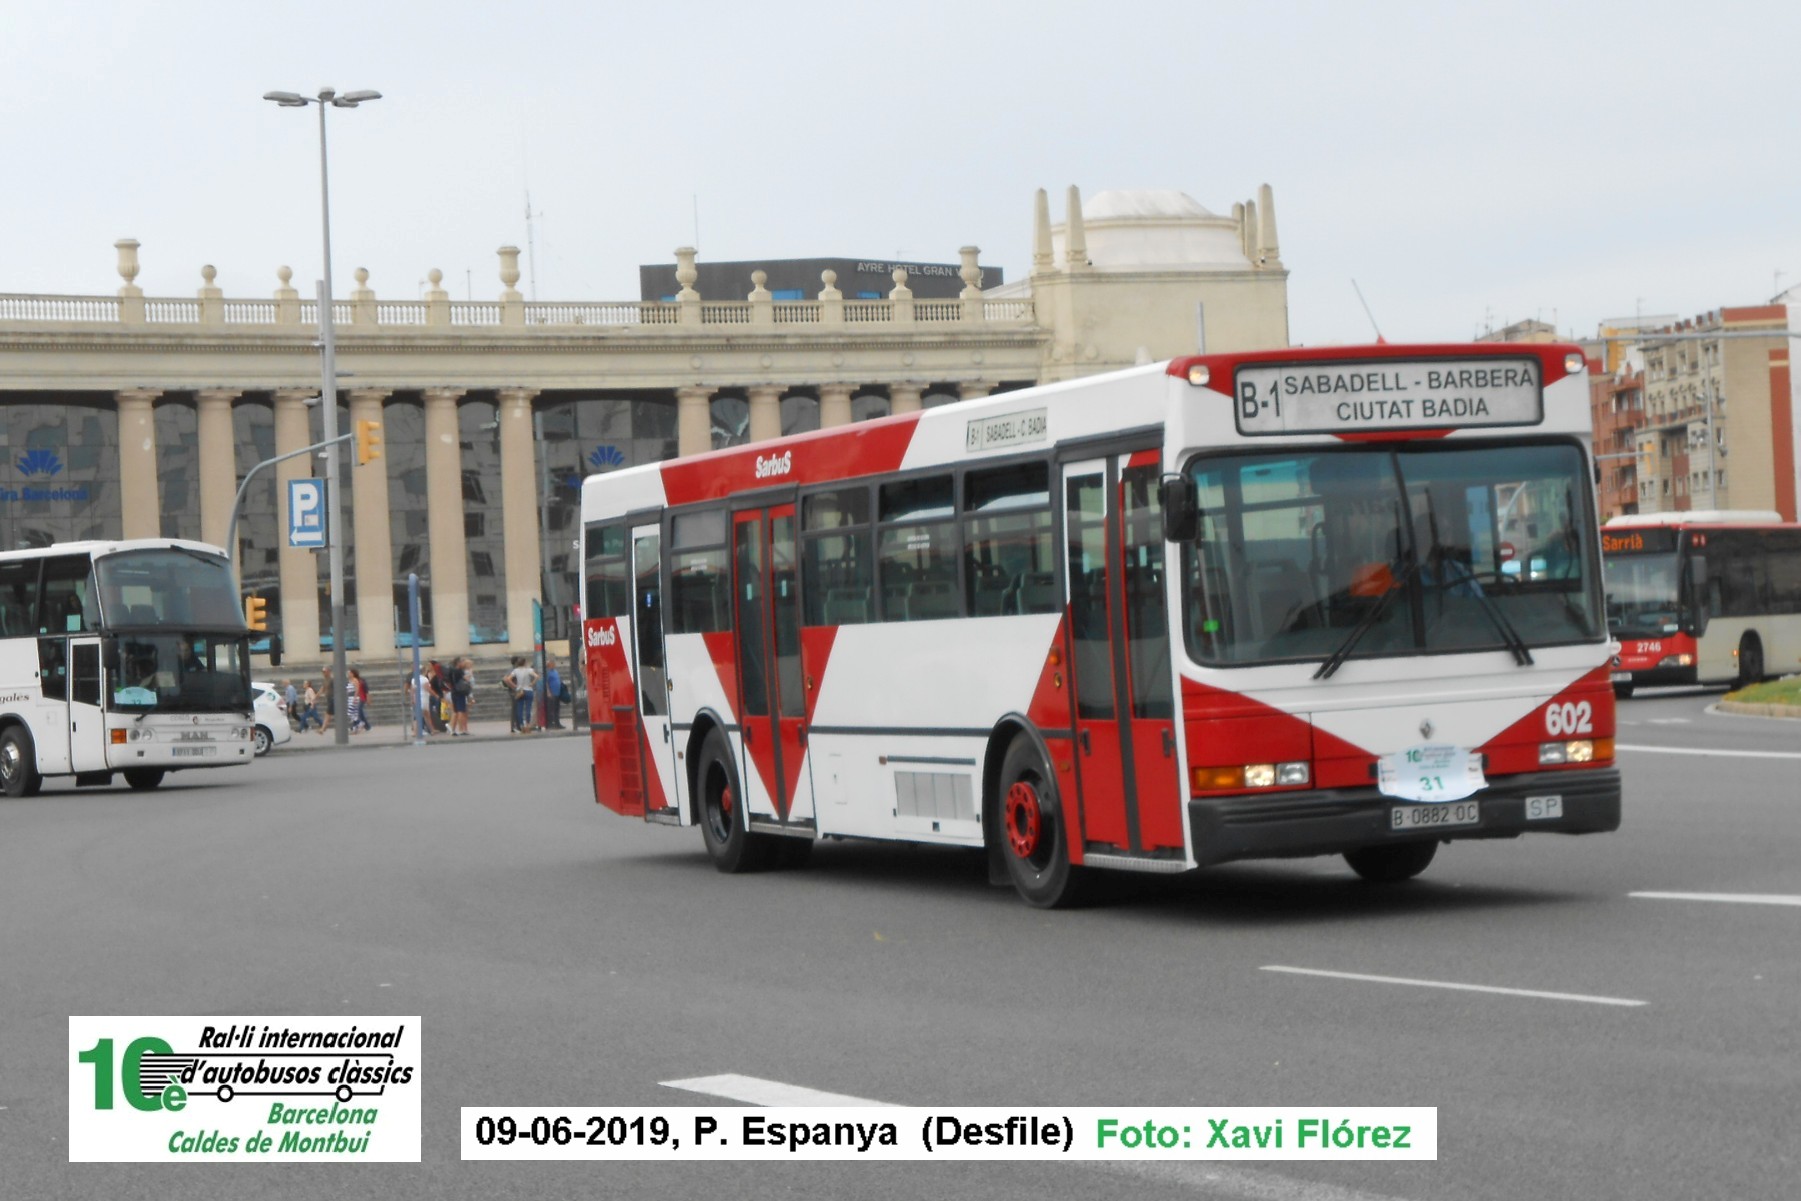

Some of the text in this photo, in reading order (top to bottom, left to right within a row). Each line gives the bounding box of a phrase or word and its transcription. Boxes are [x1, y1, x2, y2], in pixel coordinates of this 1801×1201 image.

[857, 262, 884, 273] AYRE
[923, 265, 952, 277] GRAN
[1285, 373, 1408, 395] SABADELL
[1428, 363, 1534, 389] BARBERÀ
[1241, 380, 1280, 419] B-1
[1337, 398, 1489, 421] CIUTAT BADIA
[986, 421, 1016, 443] SABADELL
[292, 483, 318, 527] P
[1602, 533, 1643, 550] Sarrià
[1637, 641, 1661, 653] 2746
[1545, 700, 1593, 736] 602
[1420, 776, 1443, 791] 31
